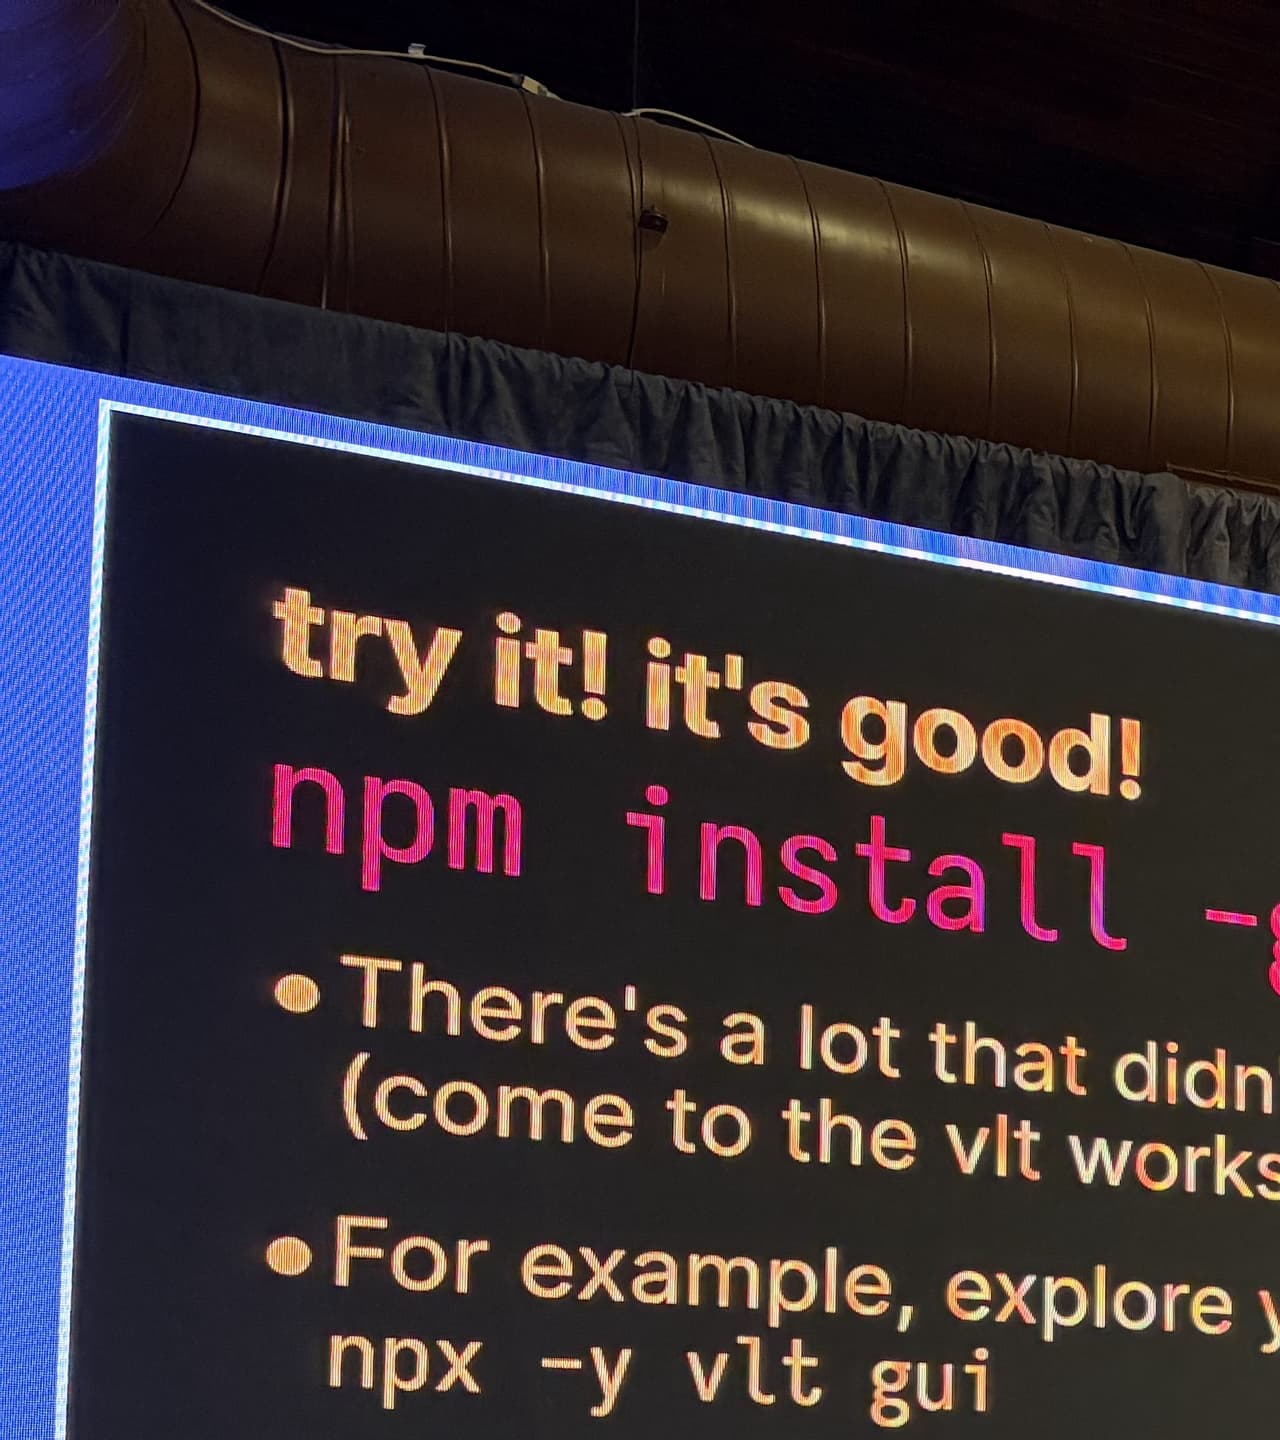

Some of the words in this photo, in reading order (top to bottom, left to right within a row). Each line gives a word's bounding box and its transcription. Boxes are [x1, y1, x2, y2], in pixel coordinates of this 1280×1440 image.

[272, 587, 463, 716] try
[494, 611, 608, 721] it!
[645, 636, 810, 750] it's
[840, 695, 1142, 801] good!
[272, 763, 522, 892] npm
[626, 784, 1128, 951] install
[339, 954, 688, 1058] There's
[719, 1012, 765, 1065] a
[799, 1003, 901, 1079] lot
[928, 1020, 1088, 1096] that
[343, 1051, 635, 1148] (come
[665, 1088, 752, 1157] to
[781, 1097, 917, 1171] the
[945, 1113, 1041, 1182] vlt
[335, 1214, 490, 1294] For
[520, 1243, 914, 1333] example,
[946, 1263, 1233, 1343] explore
[329, 1334, 483, 1410] npx
[686, 1335, 823, 1407] vlt
[869, 1347, 989, 1428] gui
